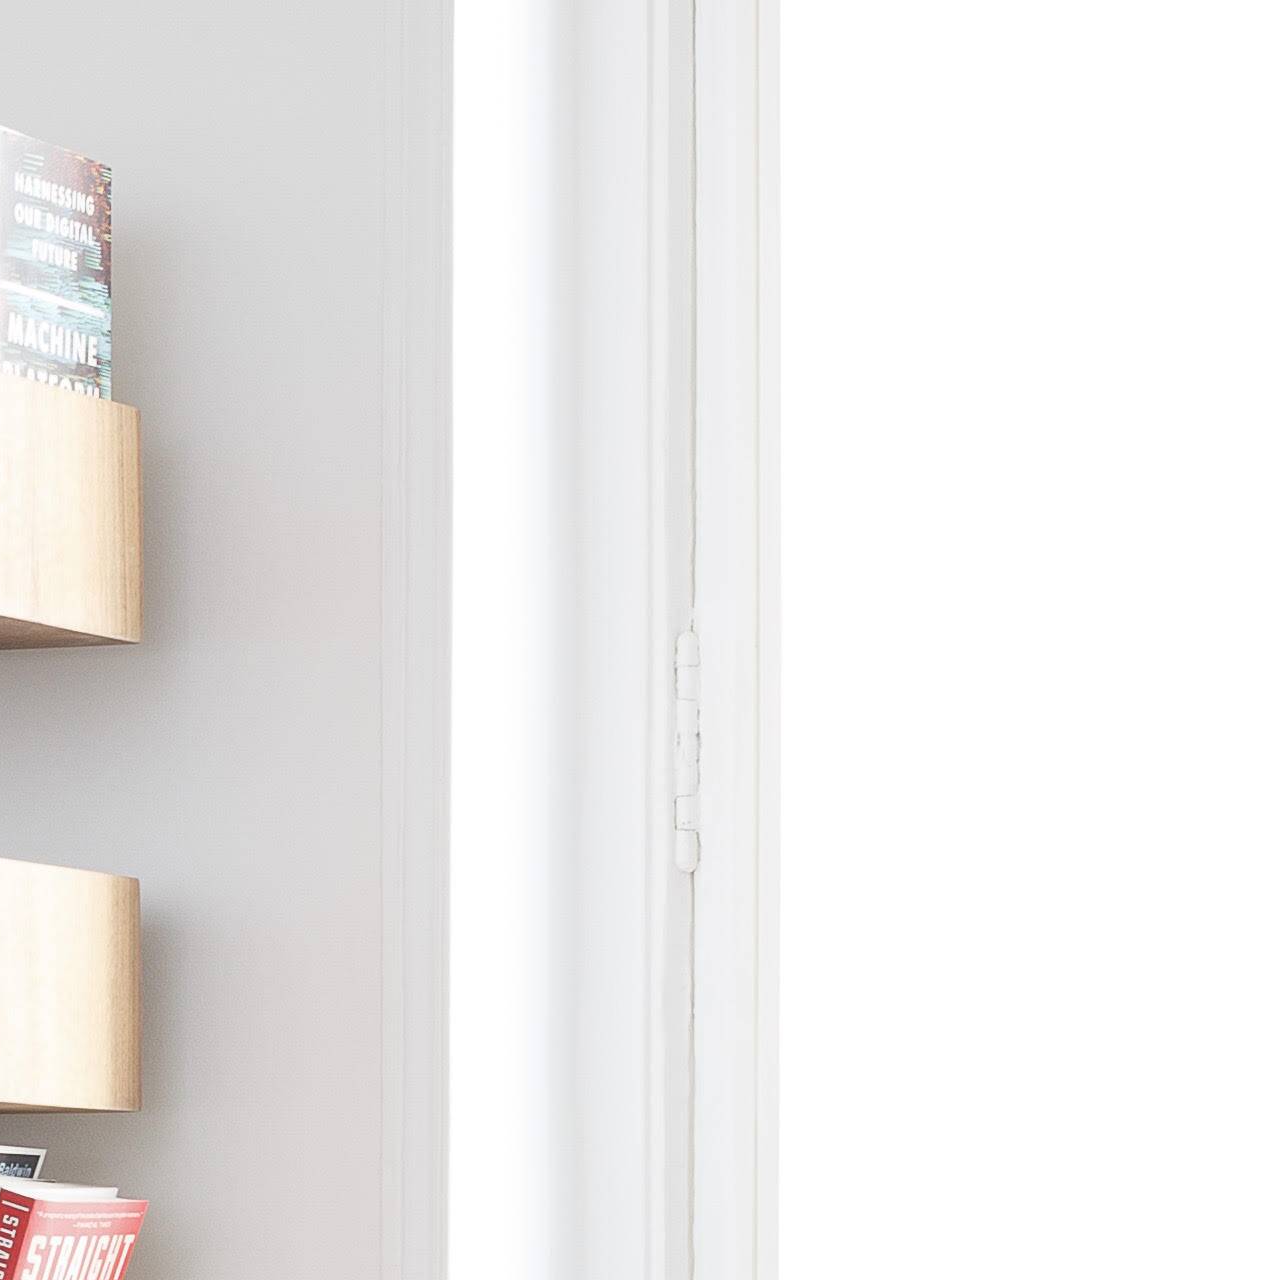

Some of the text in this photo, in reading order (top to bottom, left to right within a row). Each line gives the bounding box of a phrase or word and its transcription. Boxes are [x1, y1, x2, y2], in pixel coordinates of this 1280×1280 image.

[13, 171, 95, 216] HARNESSING
[14, 203, 98, 245] OUR DIGITAL
[8, 312, 100, 366] MACHINE
